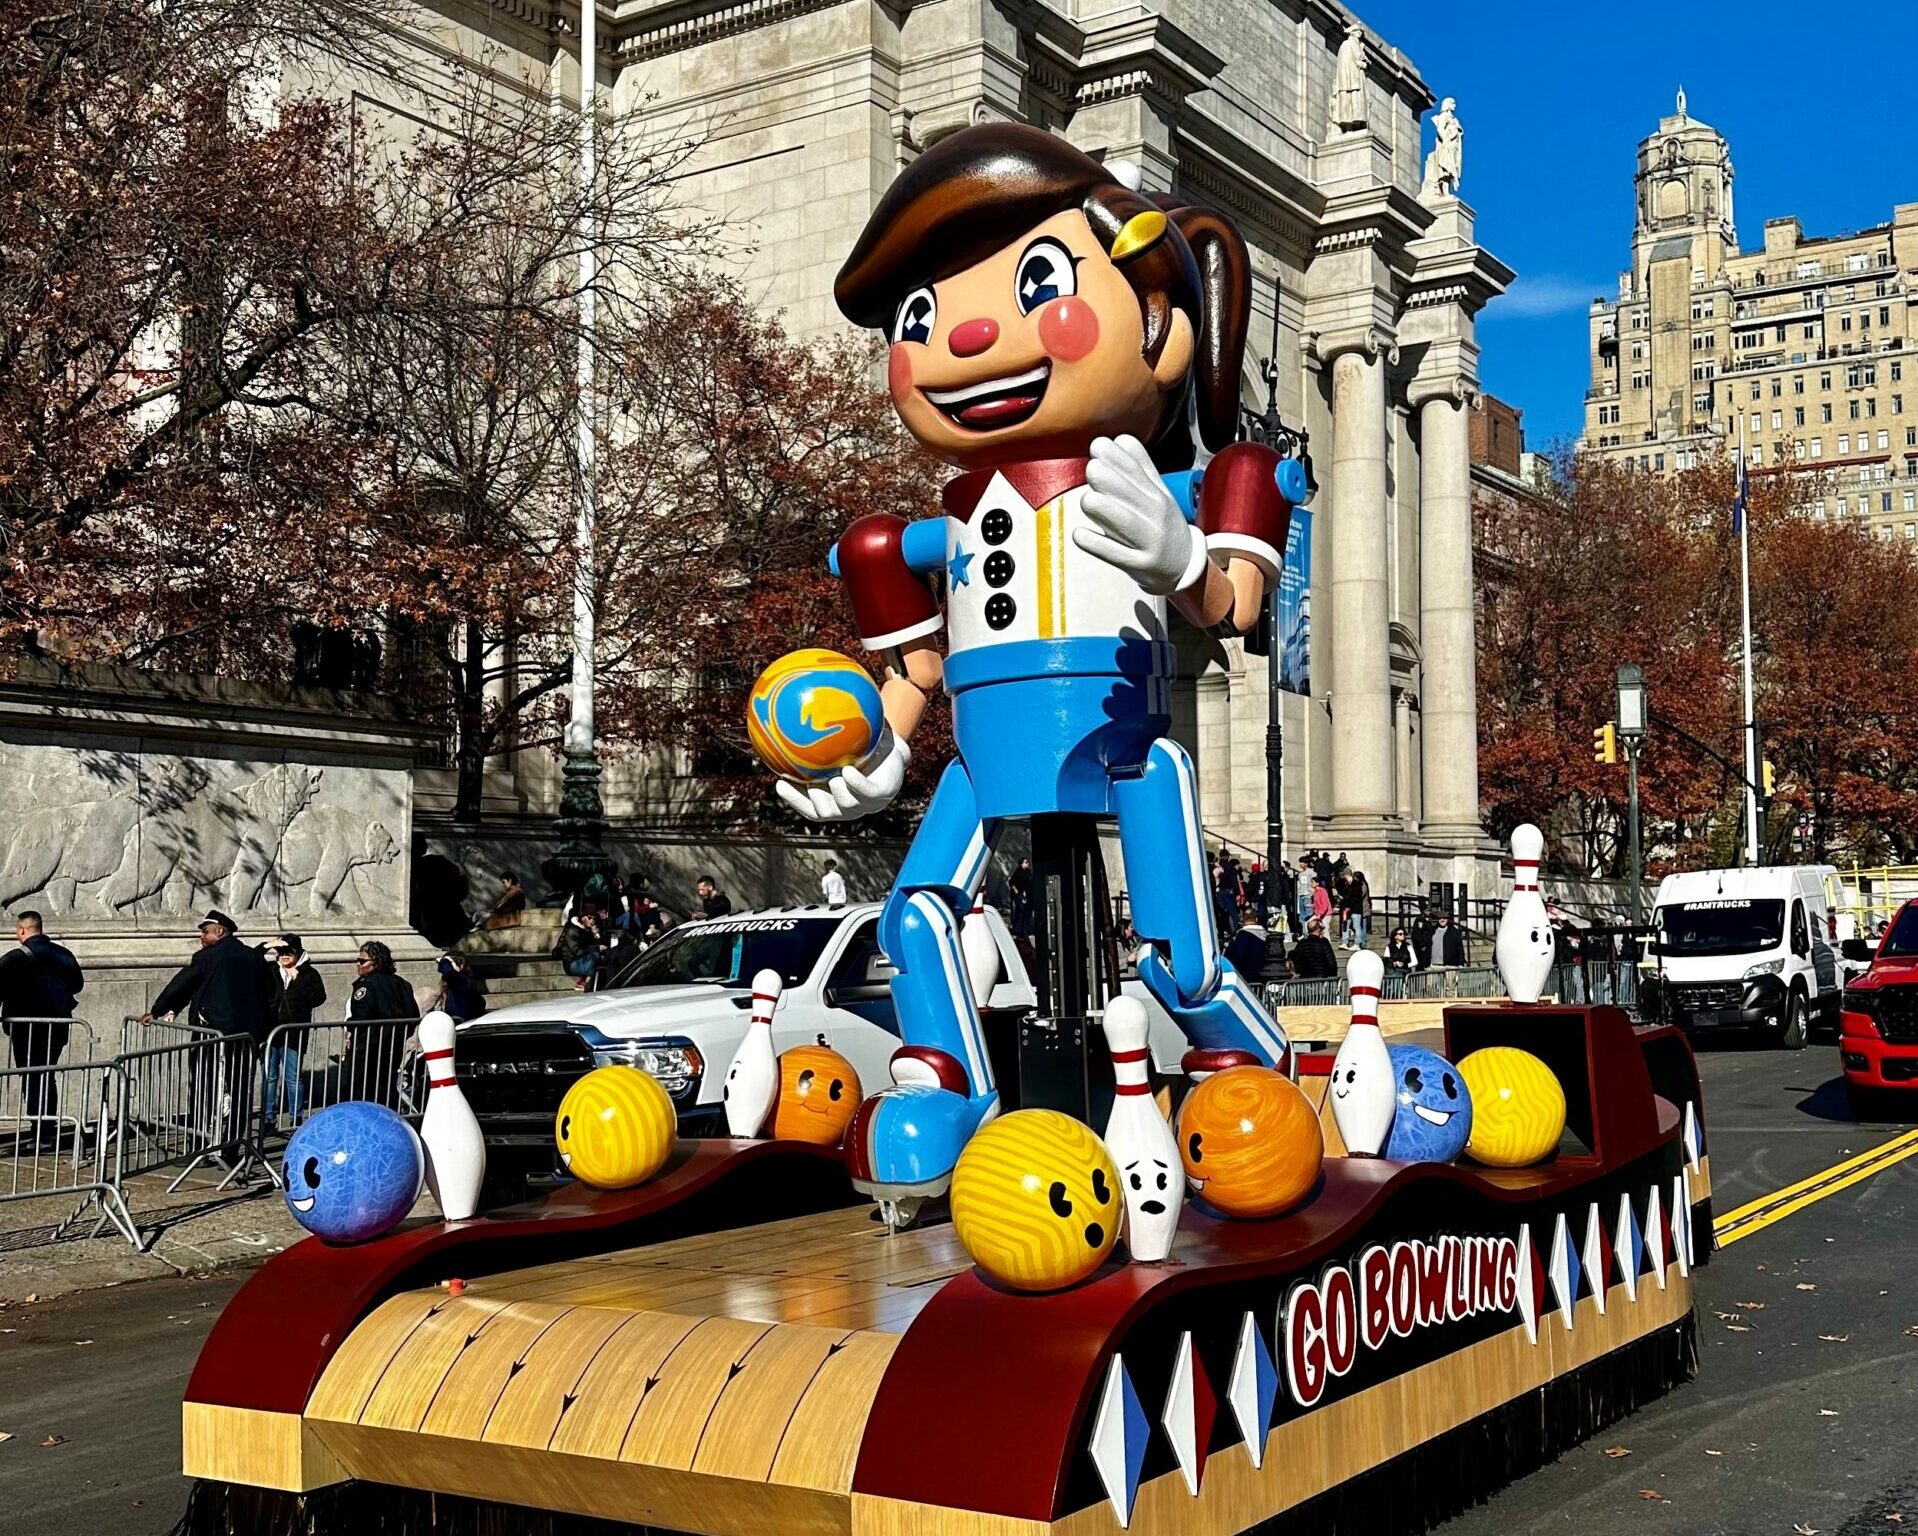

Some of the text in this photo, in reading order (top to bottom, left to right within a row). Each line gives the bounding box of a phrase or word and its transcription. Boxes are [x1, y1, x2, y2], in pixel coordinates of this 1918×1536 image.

[1684, 900, 1751, 911] #RAMTRUCKS
[683, 920, 798, 938] #RAMTRUCKS
[1286, 1234, 1518, 1407] GO BOWLING
